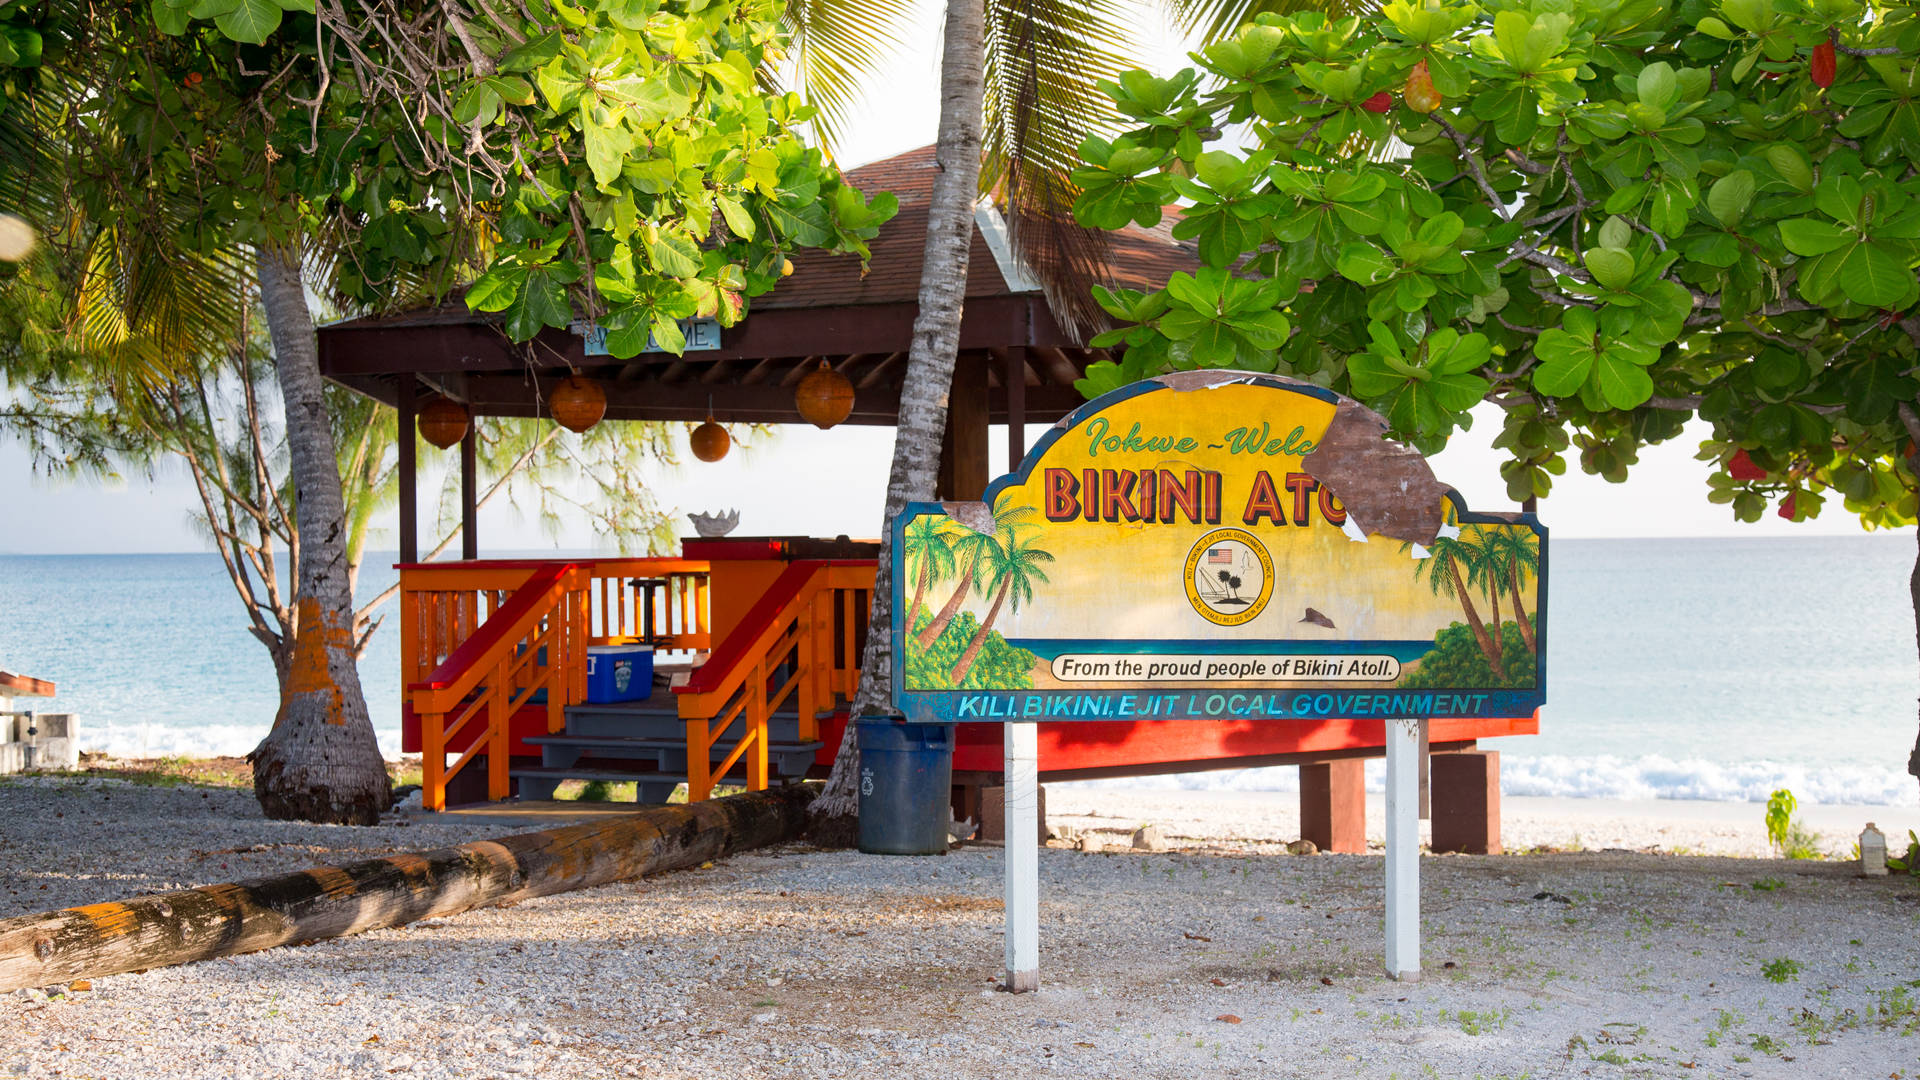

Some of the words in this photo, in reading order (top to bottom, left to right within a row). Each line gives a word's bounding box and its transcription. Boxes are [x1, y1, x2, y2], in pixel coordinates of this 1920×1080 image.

[1044, 467, 1223, 526] BIKINI
[1242, 470, 1348, 528] ATO
[1216, 531, 1233, 540] LOCAL
[1234, 531, 1264, 556] GOVERNMENT
[1061, 658, 1110, 676] From
[1115, 659, 1143, 676] the
[1147, 659, 1202, 680] proud
[1205, 659, 1266, 680] people
[1271, 659, 1291, 676] of
[1293, 659, 1343, 676] Bikini
[1347, 659, 1393, 676] Atoll.
[1186, 694, 1283, 717] LOCAL
[1291, 693, 1489, 716] GOVERNMENT
